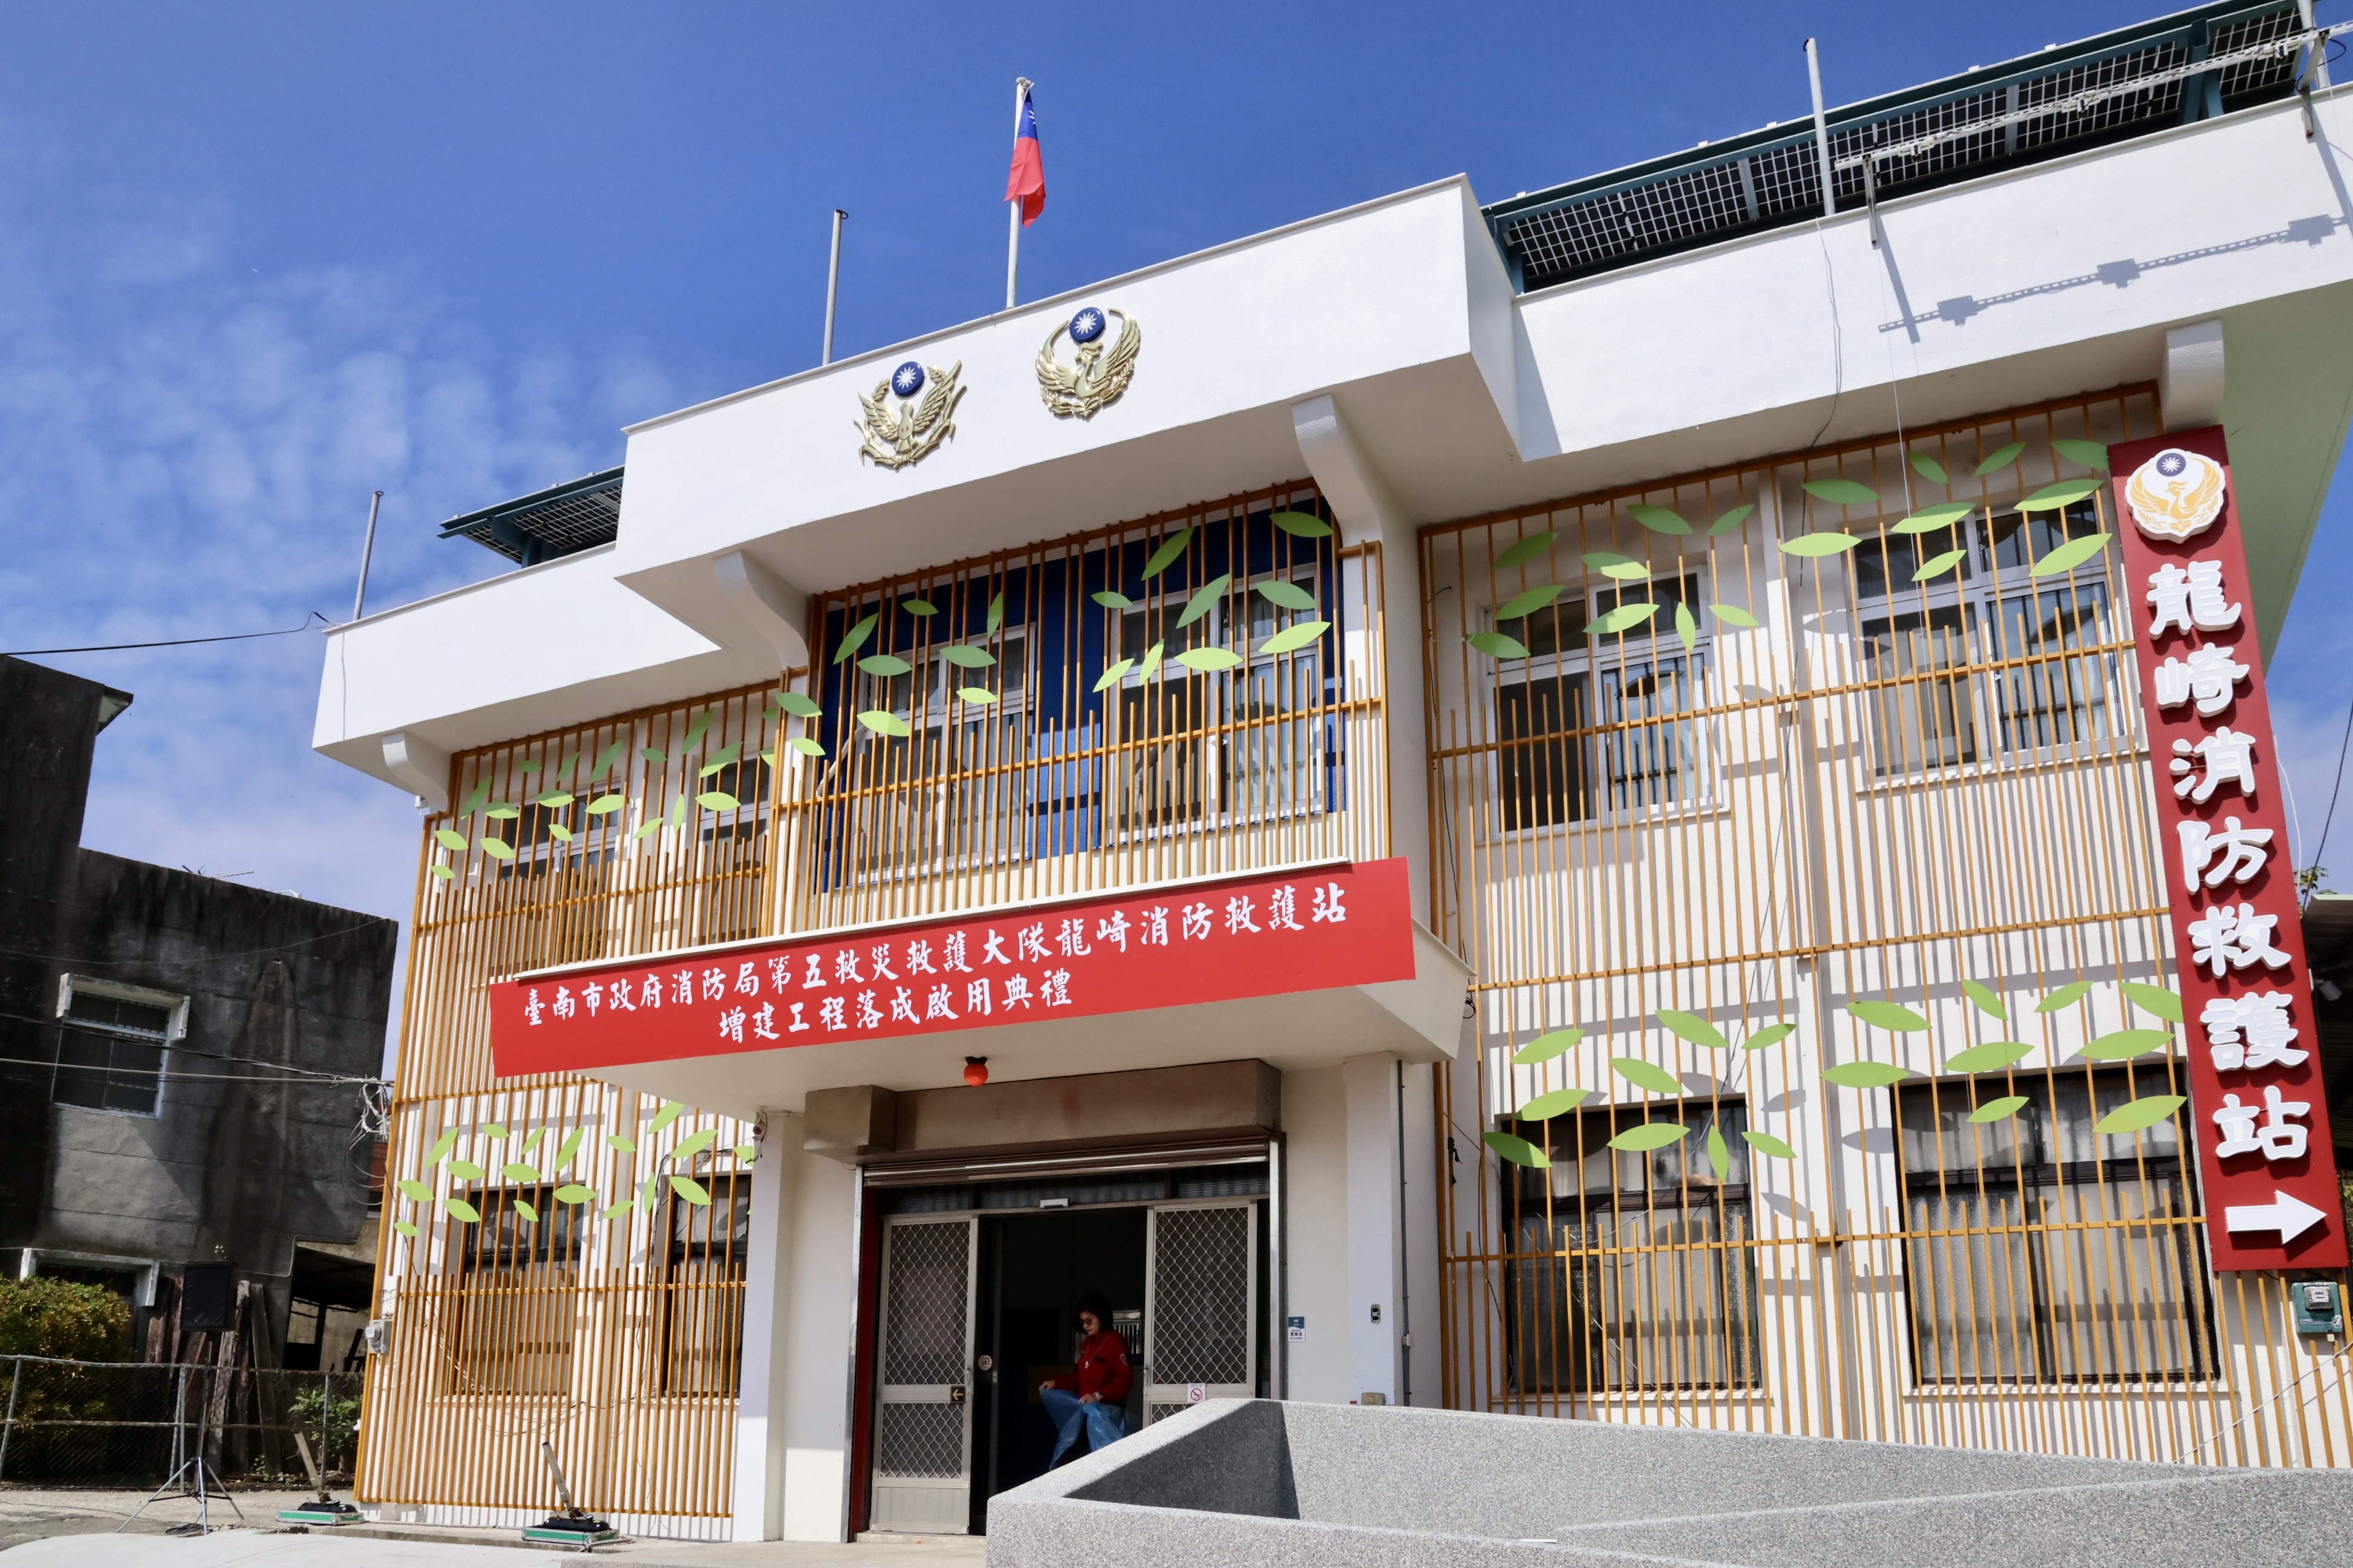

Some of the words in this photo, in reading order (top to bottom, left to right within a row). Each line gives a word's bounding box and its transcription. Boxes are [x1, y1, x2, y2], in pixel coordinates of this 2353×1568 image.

[2145, 559, 2312, 1161] 龍崎消防救護站
[524, 881, 1347, 1027] 臺南市政府消防局第五救災救護大隊龍崎消防救護站
[718, 967, 1073, 1044] 增建工程落成啟用典禮
